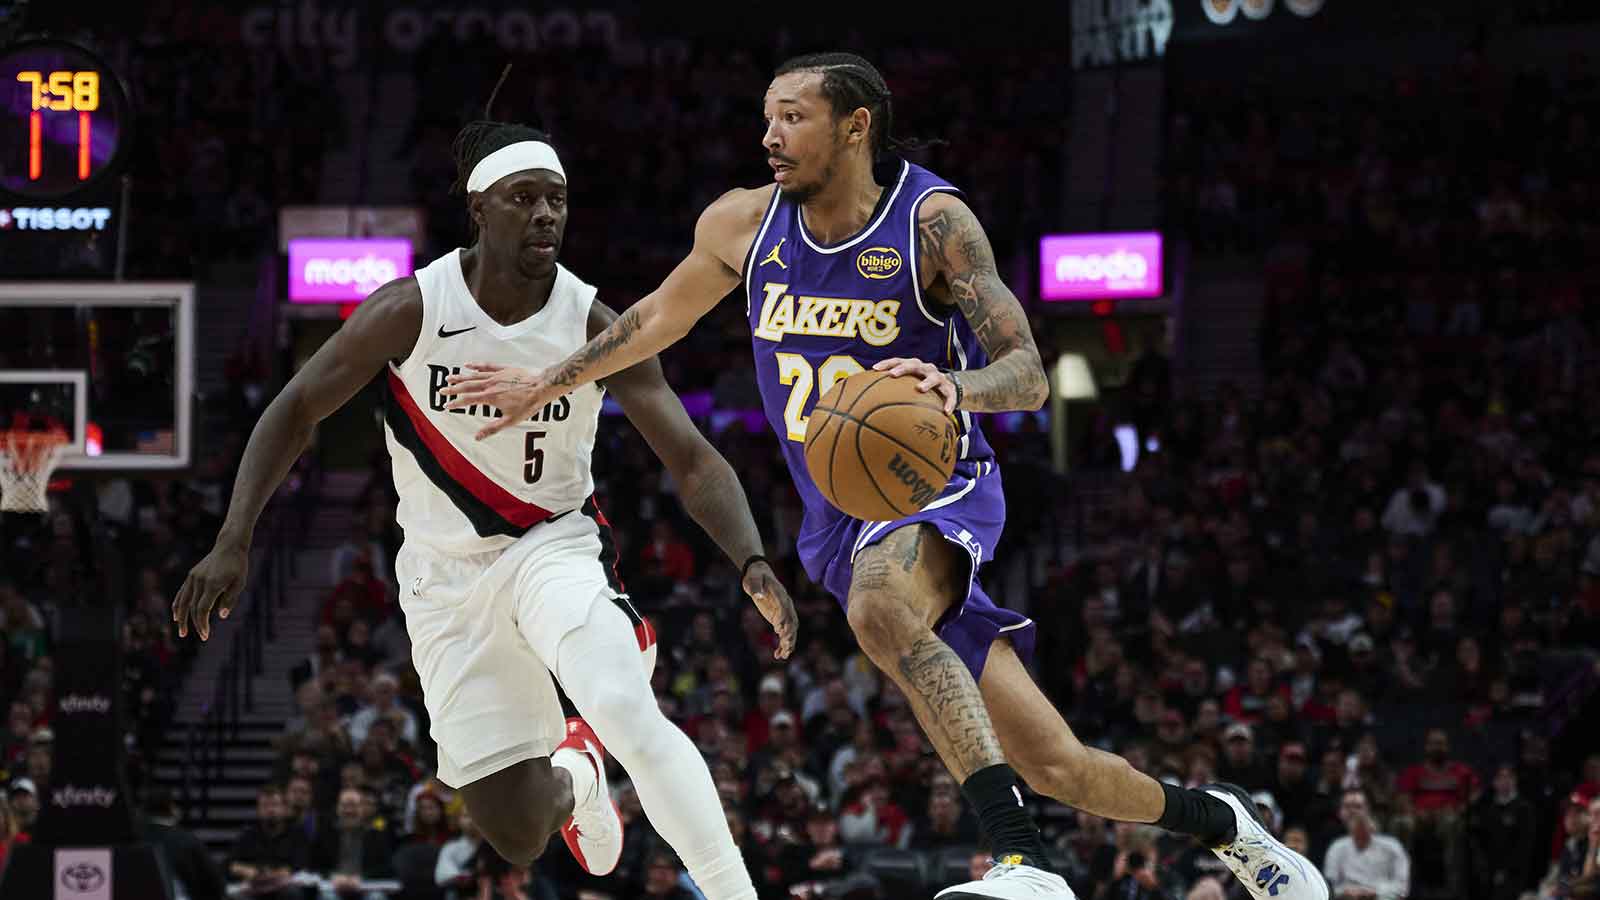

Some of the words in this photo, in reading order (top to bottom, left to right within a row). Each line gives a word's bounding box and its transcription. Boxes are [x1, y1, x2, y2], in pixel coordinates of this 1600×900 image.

[16, 71, 100, 112] 7:58
[12, 207, 111, 230] TISSOT
[861, 255, 899, 270] bibigo
[754, 282, 901, 346] LAKERS
[523, 431, 548, 485] 5
[59, 693, 112, 716] xfinity
[52, 784, 117, 808] xfinity
